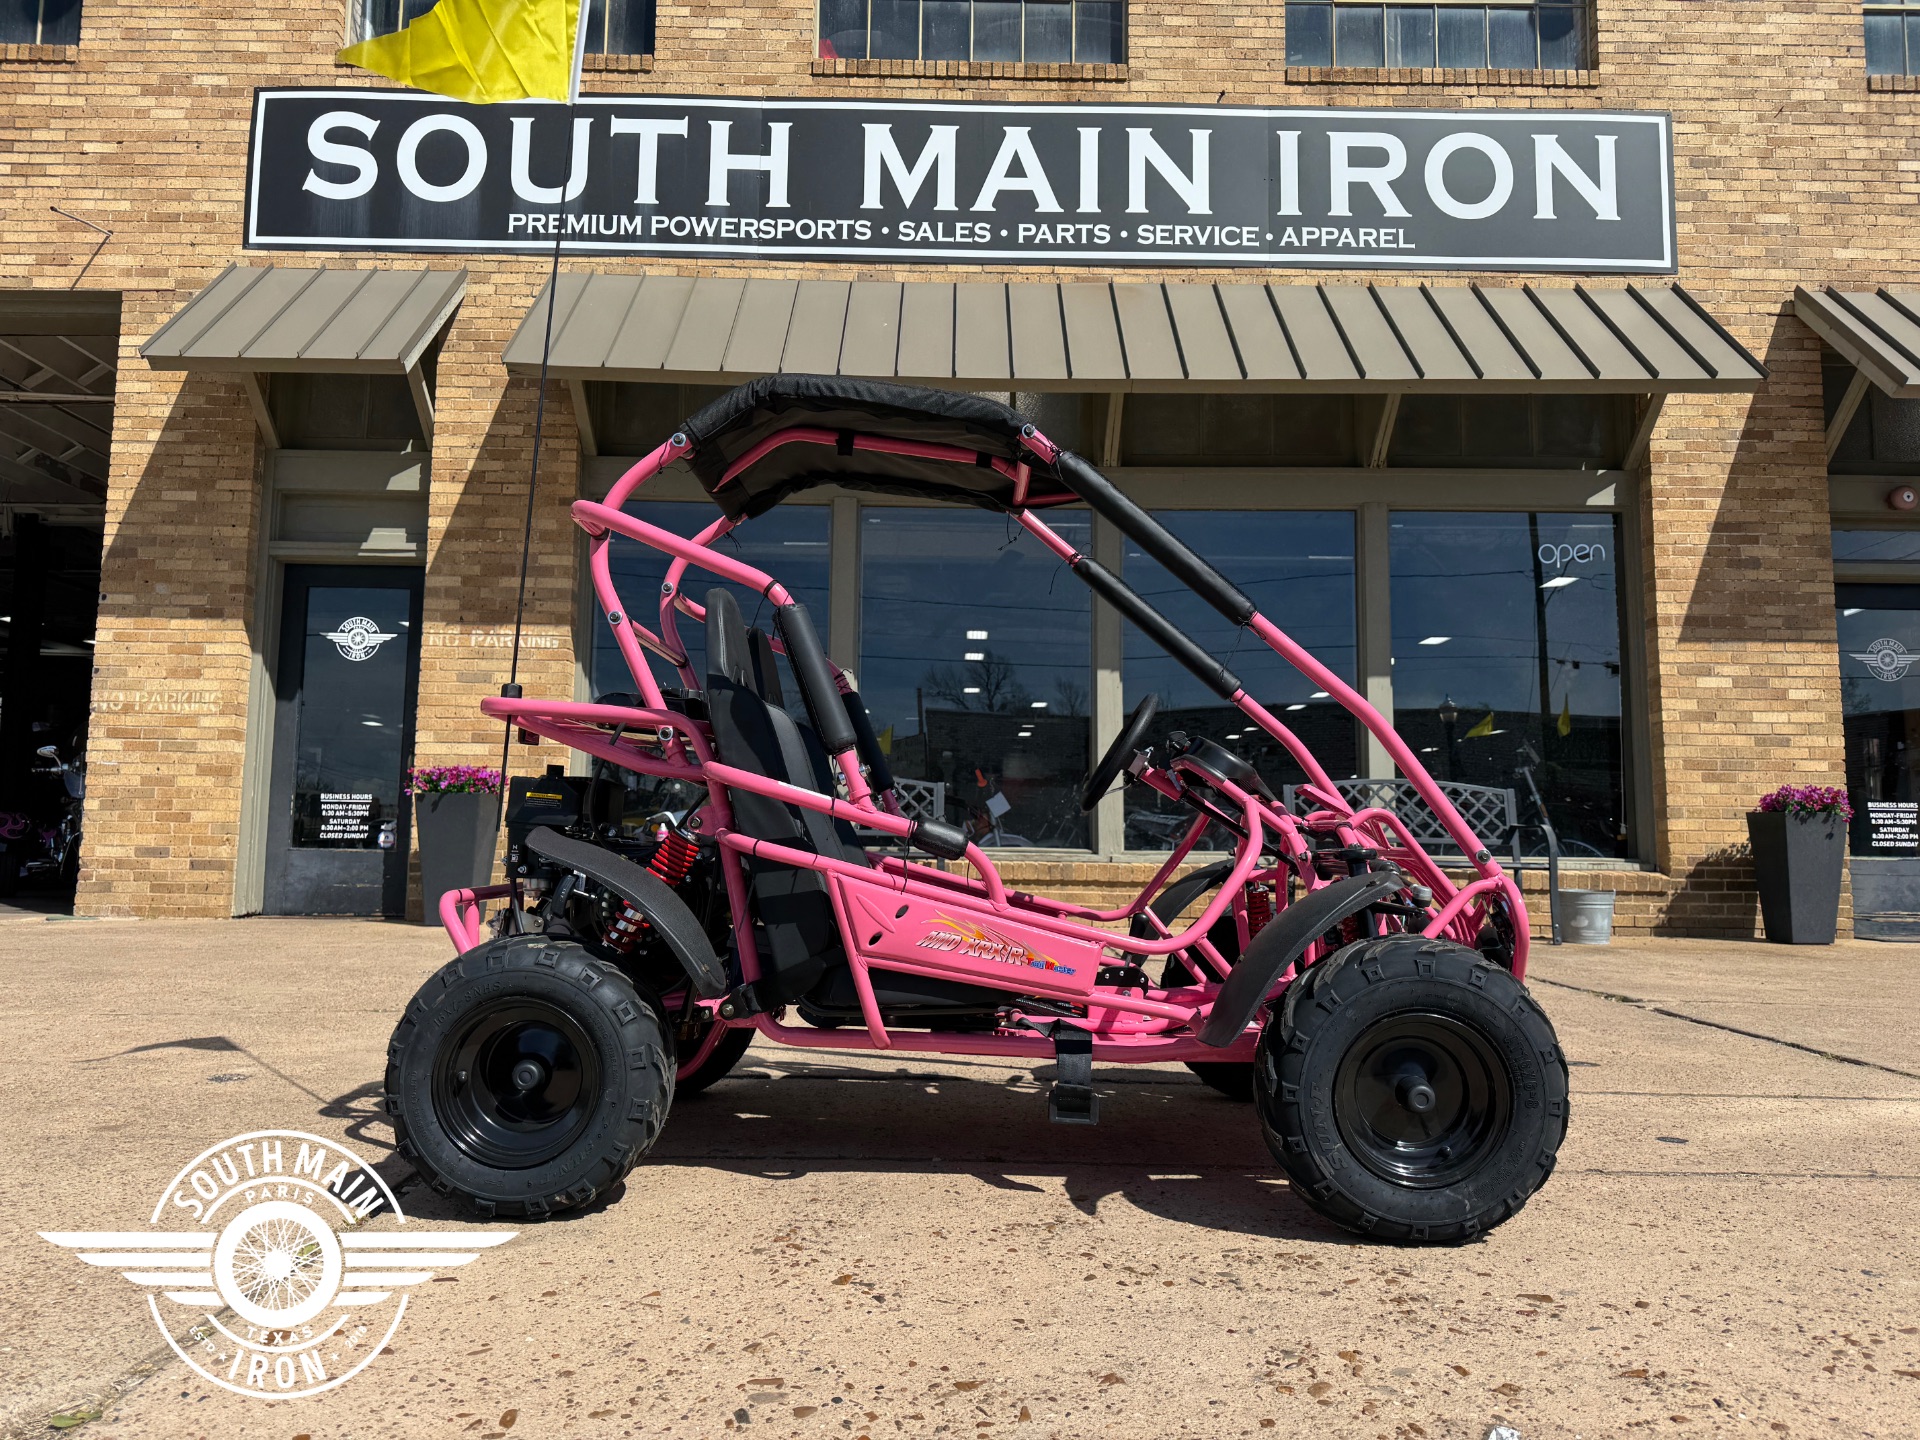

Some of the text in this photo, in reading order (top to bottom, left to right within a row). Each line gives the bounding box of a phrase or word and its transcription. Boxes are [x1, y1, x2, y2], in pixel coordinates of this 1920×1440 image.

[301, 110, 1622, 221] SOUTH MAIN IRON
[507, 213, 1417, 251] PREMIUM POWERSPORTS SALES PARTS SERVICE APPAREL
[1538, 543, 1606, 569] open
[428, 629, 561, 649] NO PARKING
[134, 690, 223, 714] PARKING
[915, 930, 963, 952] MID
